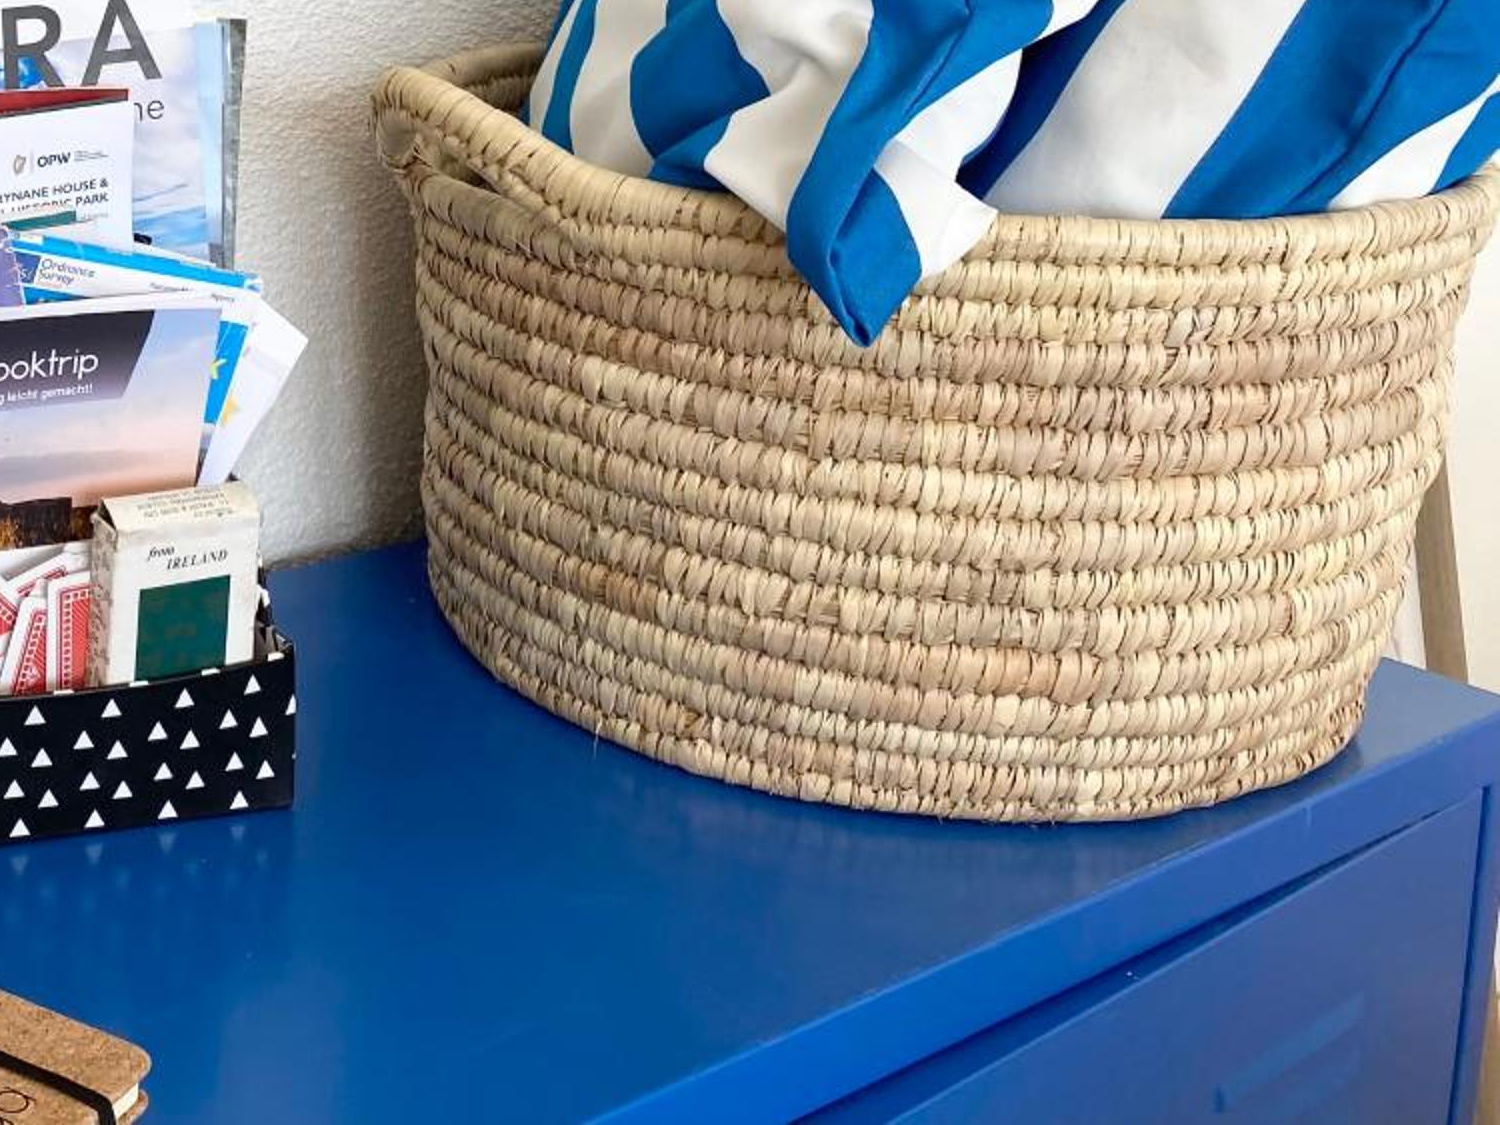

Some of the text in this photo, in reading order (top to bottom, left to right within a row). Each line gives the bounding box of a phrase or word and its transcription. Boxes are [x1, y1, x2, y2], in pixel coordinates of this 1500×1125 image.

[37, 152, 71, 168] OPW
[53, 178, 97, 195] HOUSE
[99, 177, 109, 189] &
[75, 192, 110, 207] PARK
[39, 267, 75, 286] Survey
[41, 257, 96, 278] Ordnance
[6, 388, 38, 402] leicht
[147, 545, 176, 563] from
[166, 549, 228, 571] IRELAND
